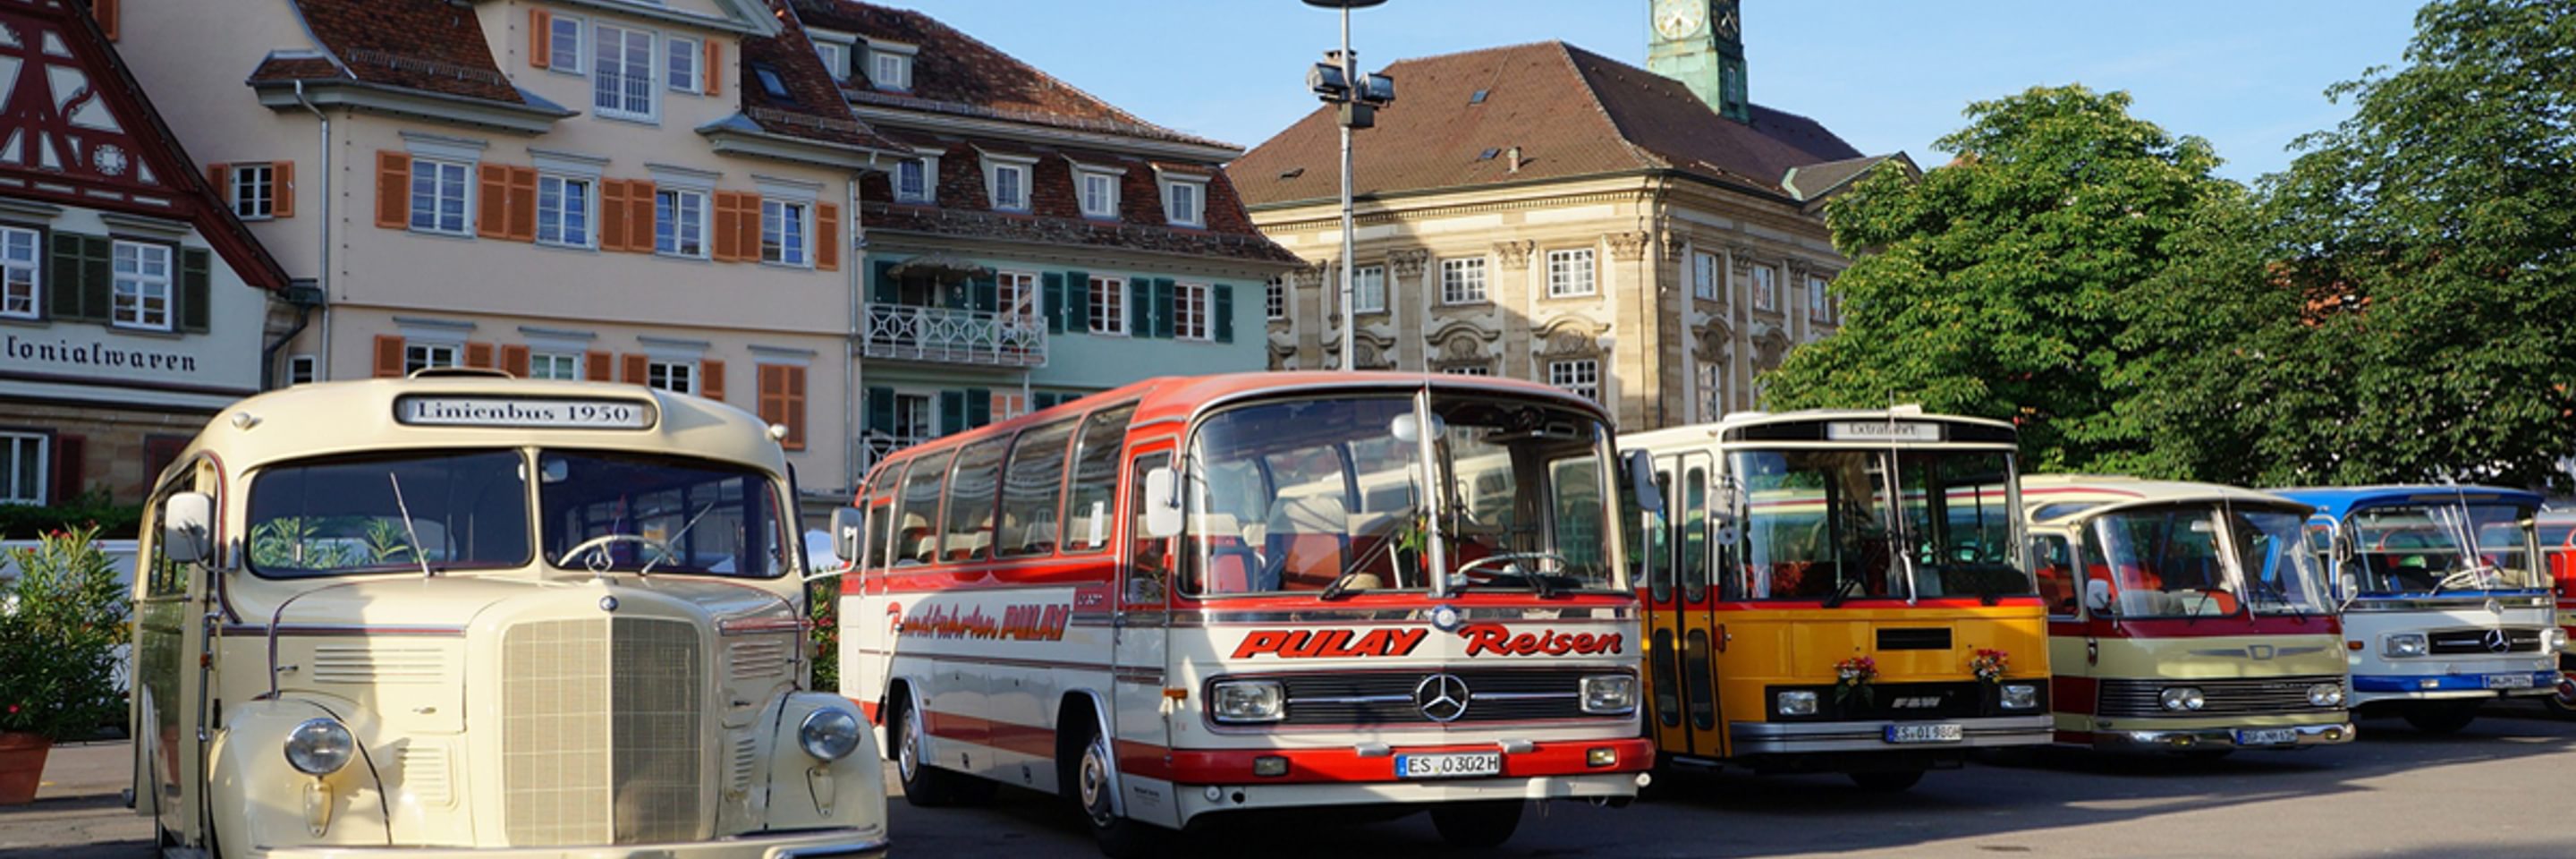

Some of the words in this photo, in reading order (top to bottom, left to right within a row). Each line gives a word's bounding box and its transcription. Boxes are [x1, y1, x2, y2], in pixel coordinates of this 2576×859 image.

[418, 401, 555, 421] Linienbus
[568, 405, 631, 422] 1950
[1000, 604, 1071, 642] PULAY
[1231, 628, 1428, 659] PULAY
[1458, 623, 1624, 656] Reisen
[1408, 759, 1431, 773] ES
